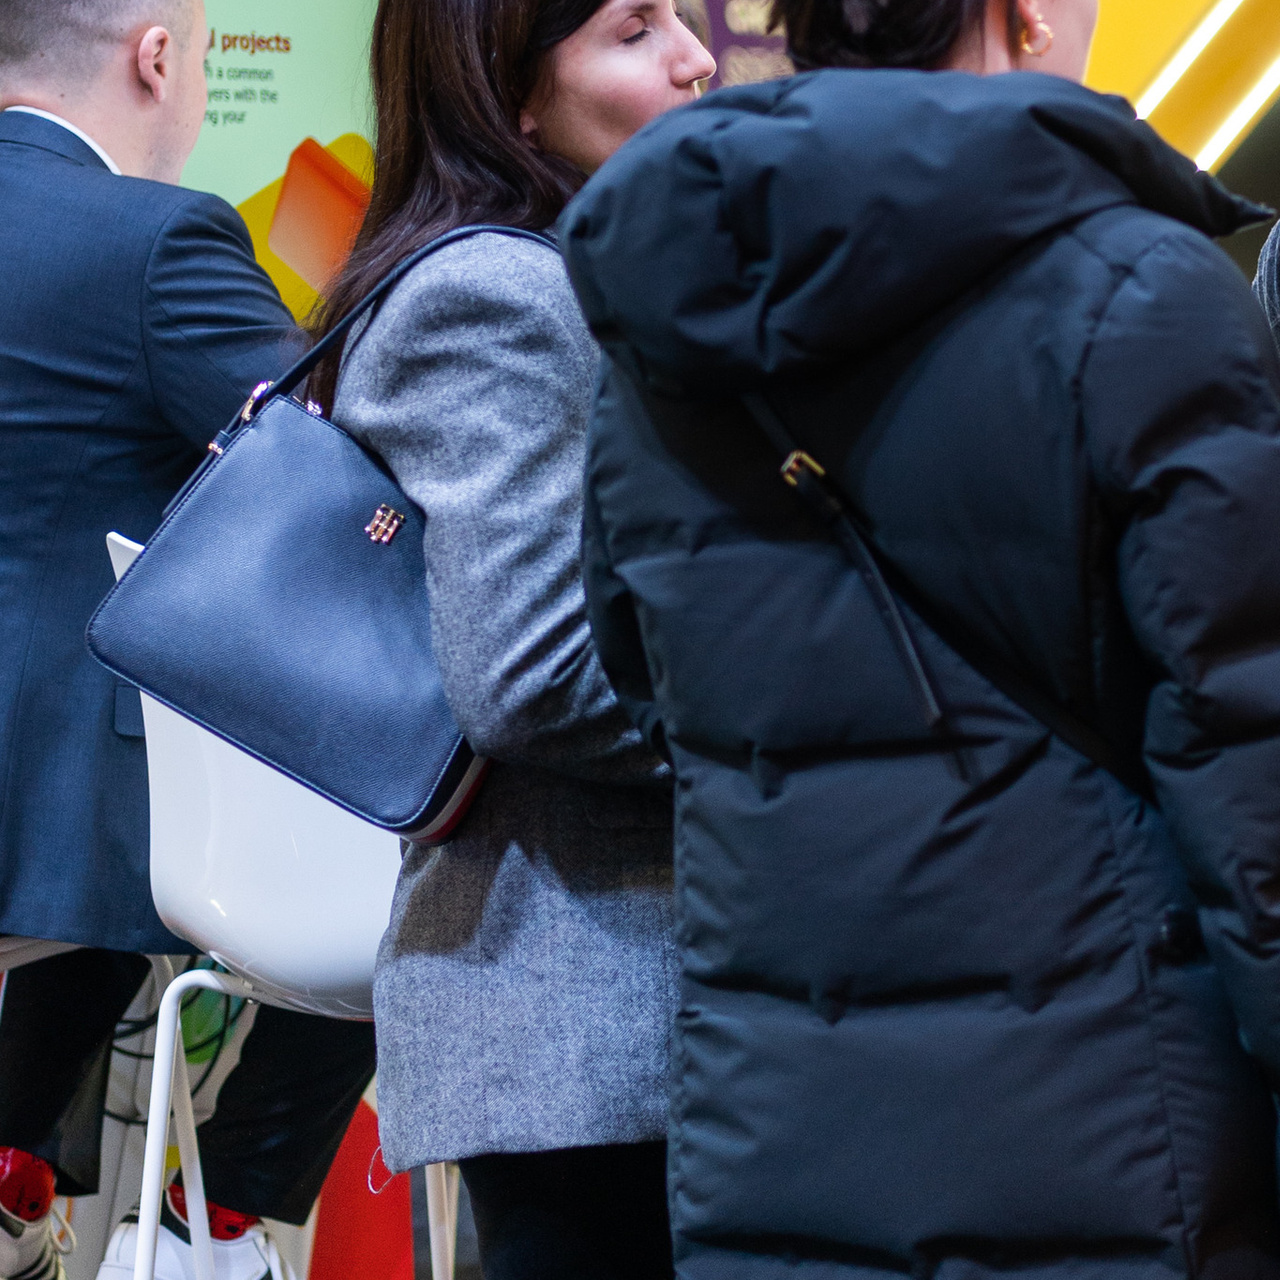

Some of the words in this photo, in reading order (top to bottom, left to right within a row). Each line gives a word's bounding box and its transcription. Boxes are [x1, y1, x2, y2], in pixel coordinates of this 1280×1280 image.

[221, 31, 291, 55] projects
[227, 67, 274, 81] common
[234, 87, 256, 101] with
[260, 89, 278, 103] the
[222, 110, 247, 125] your
